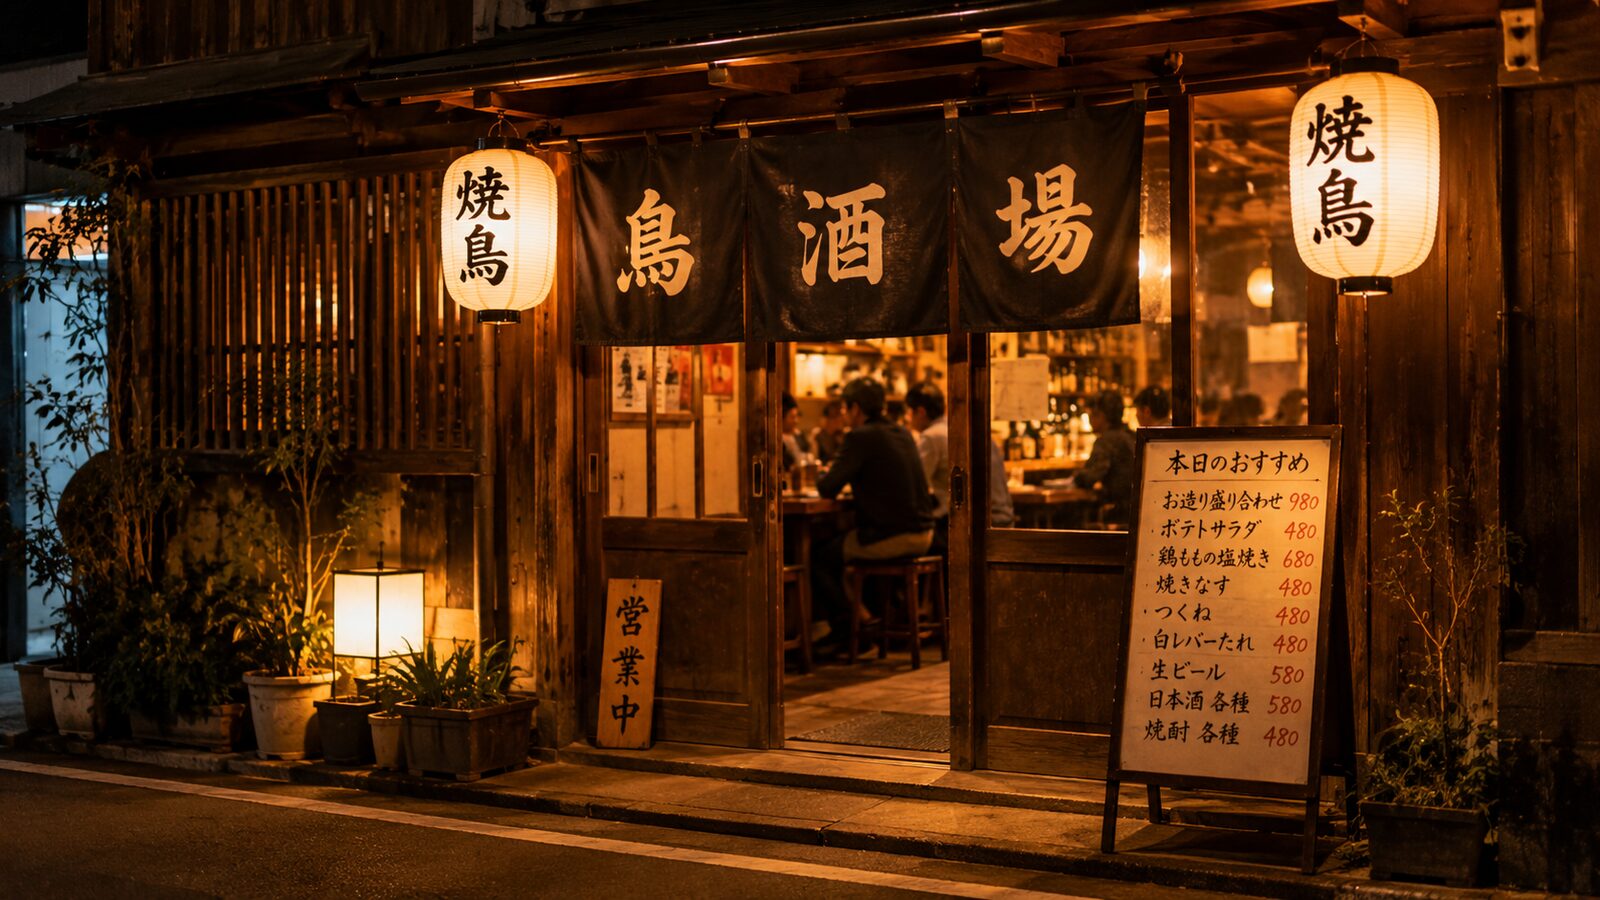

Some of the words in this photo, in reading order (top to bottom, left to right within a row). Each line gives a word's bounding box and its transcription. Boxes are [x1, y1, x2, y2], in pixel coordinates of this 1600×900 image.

[1306, 94, 1376, 248] 焼鳥
[455, 165, 512, 287] 焼鳥
[616, 163, 1095, 297] 鳥酒場
[1165, 449, 1310, 476] 本日のおすすめ
[1162, 489, 1284, 512] お造り盛り合わせ
[1289, 491, 1320, 512] 980
[1283, 521, 1317, 541] 480
[1158, 545, 1270, 569] 鶏ももの塩焼き
[1282, 549, 1315, 568] 680
[1155, 573, 1230, 597] 焼きなす
[1278, 577, 1312, 598] 480
[1154, 602, 1212, 623] つくね
[1275, 606, 1311, 627] 480
[1153, 628, 1255, 652] 白レバーたれ
[1272, 634, 1309, 655] 480
[611, 595, 650, 737] 営業中
[1150, 658, 1226, 681] 生ビール
[1269, 665, 1305, 685] 580
[1149, 688, 1204, 712] 日本酒
[1210, 690, 1250, 714] 各種
[1266, 694, 1302, 715] 580
[1143, 718, 1190, 743] 焼酎
[1197, 721, 1240, 745] 各種
[1263, 725, 1299, 747] 480
